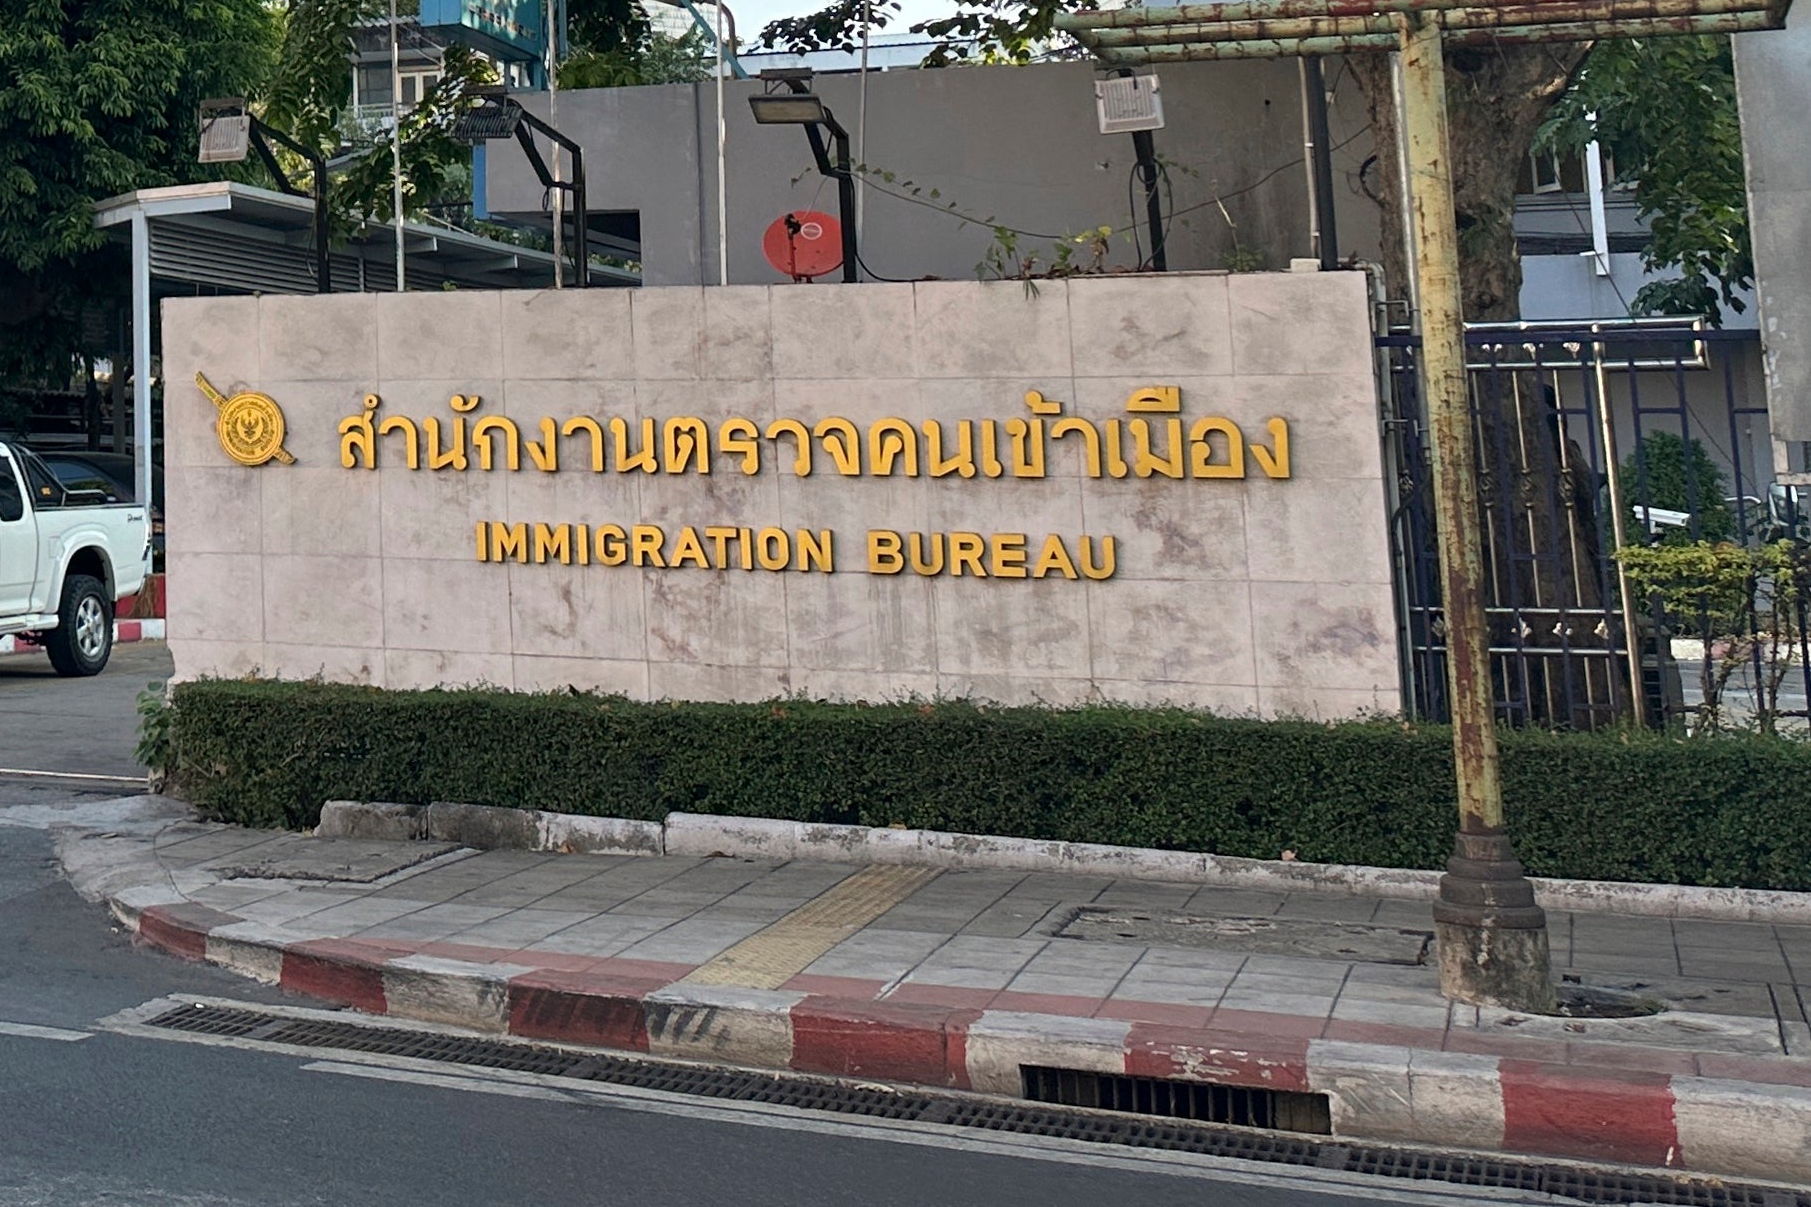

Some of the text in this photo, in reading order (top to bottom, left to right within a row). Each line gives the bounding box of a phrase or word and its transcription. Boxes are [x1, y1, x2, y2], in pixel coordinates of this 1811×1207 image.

[339, 385, 1290, 479] สำนักงานตรวจคนเข้าเมือง
[476, 520, 1117, 580] IMMIGRATION BUREAU
